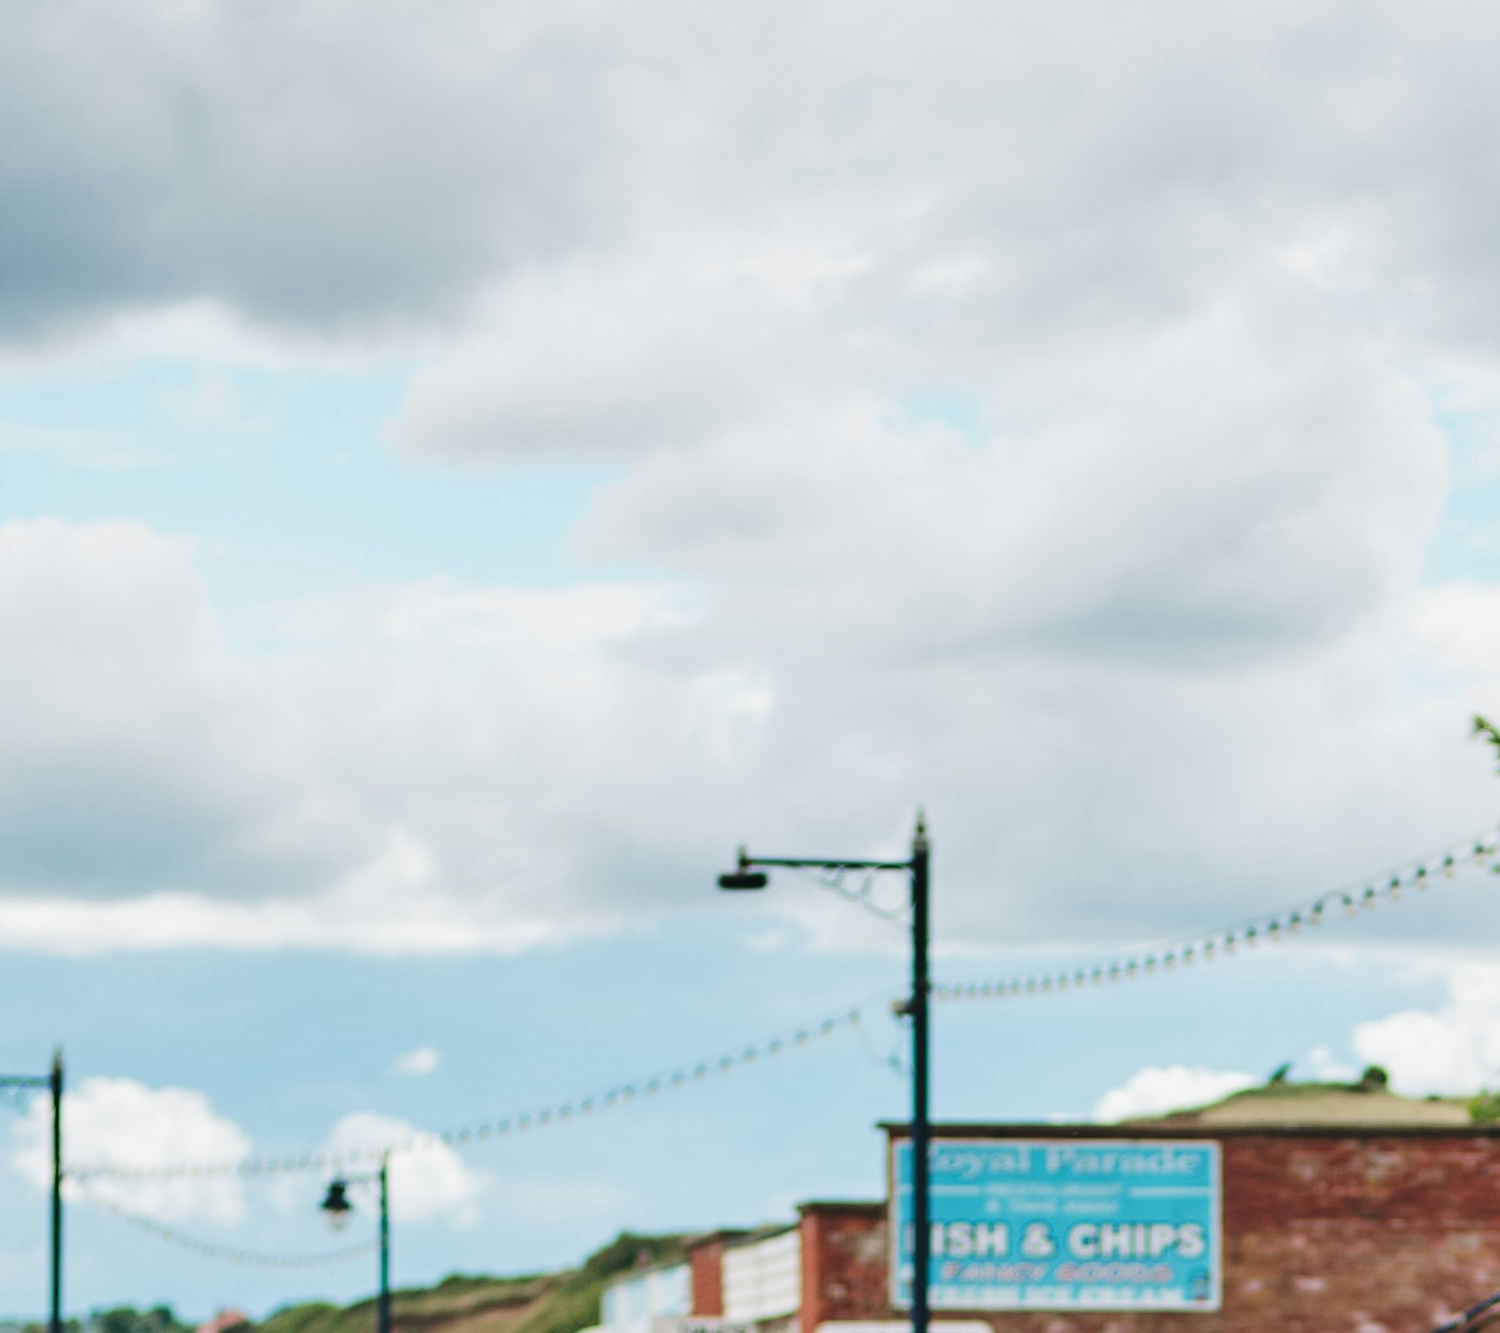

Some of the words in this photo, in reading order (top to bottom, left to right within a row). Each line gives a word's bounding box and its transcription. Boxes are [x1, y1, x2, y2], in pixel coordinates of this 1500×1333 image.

[1047, 1144, 1200, 1174] Parade
[1021, 1222, 1054, 1256] &
[1068, 1222, 1205, 1258] CHIPS
[1056, 1262, 1173, 1284] GOODS
